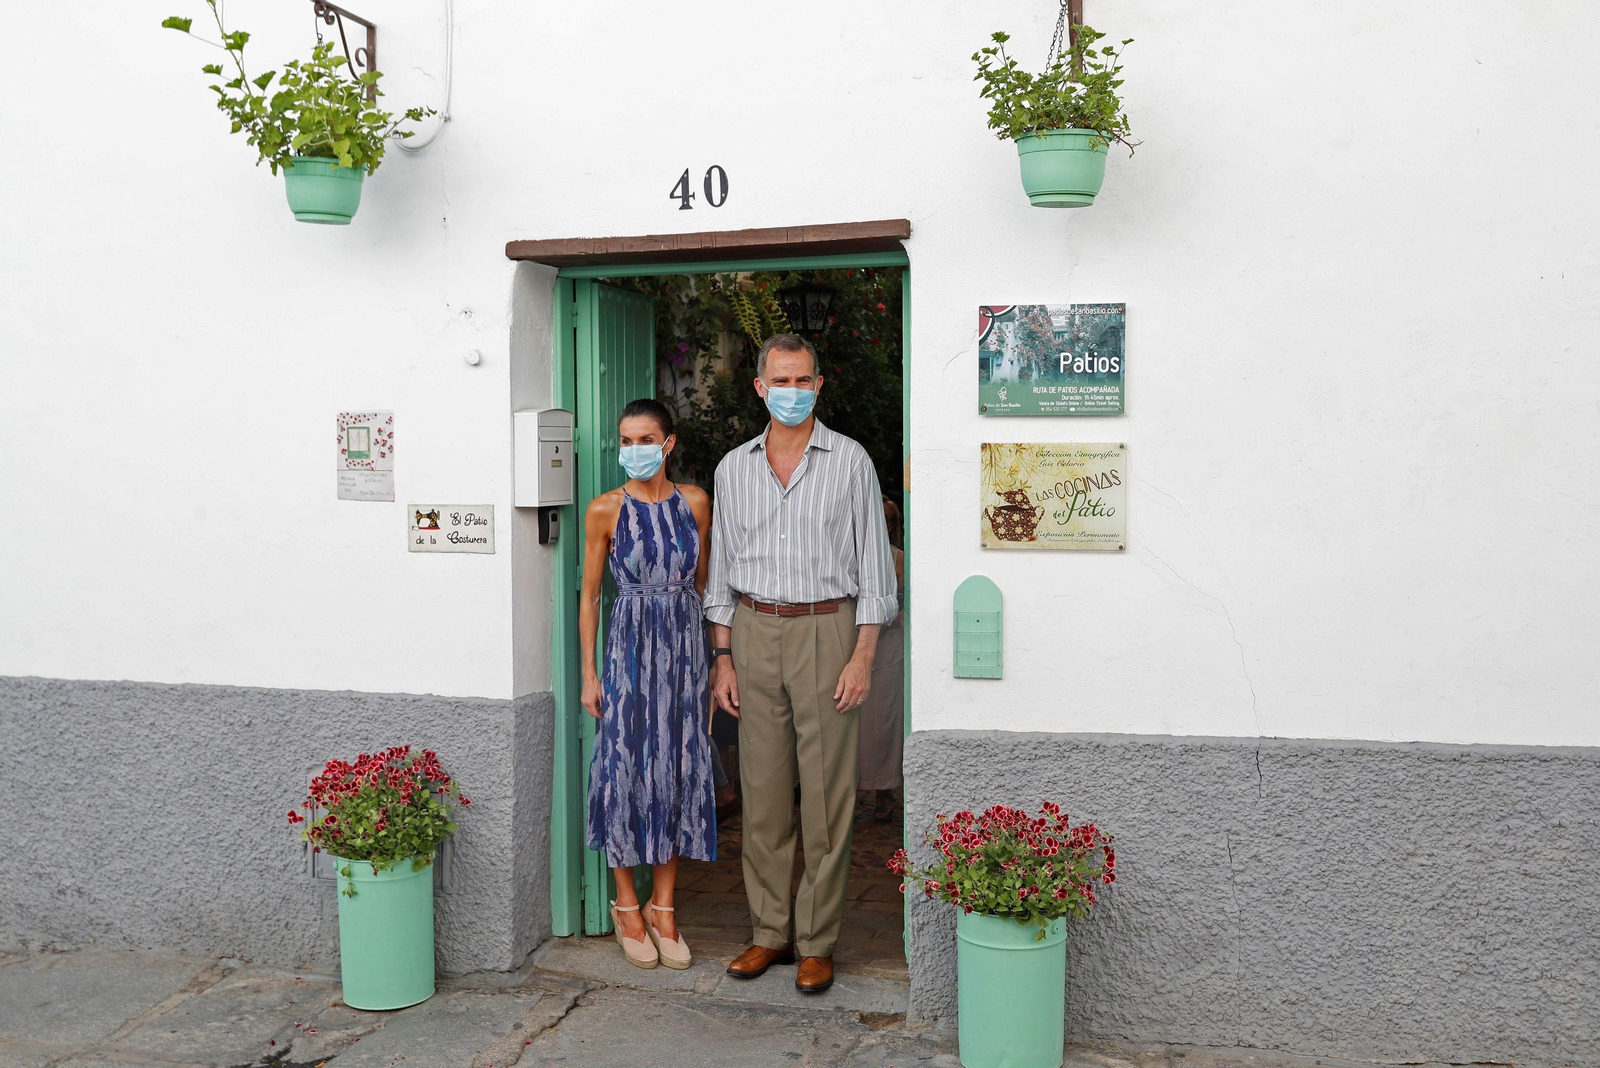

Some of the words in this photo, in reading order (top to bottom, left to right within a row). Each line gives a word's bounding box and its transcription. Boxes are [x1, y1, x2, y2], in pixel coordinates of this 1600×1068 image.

[669, 164, 729, 211] 40
[1060, 352, 1120, 374] Patios
[1079, 385, 1119, 393] ACOMPAÑADA
[1035, 449, 1071, 459] Colección
[1074, 449, 1120, 460] Etnográfica
[1037, 459, 1053, 468] Luis
[1035, 488, 1055, 502] LAS
[1054, 469, 1122, 499] COCINAS
[1052, 510, 1066, 519] del
[1057, 489, 1116, 526] Patio
[449, 512, 461, 526] El
[464, 512, 488, 527] Patio
[415, 535, 424, 545] de
[430, 535, 437, 545] la
[446, 530, 488, 544] Costurera
[1035, 530, 1075, 540] Exposición
[1077, 530, 1120, 539] Permanente
